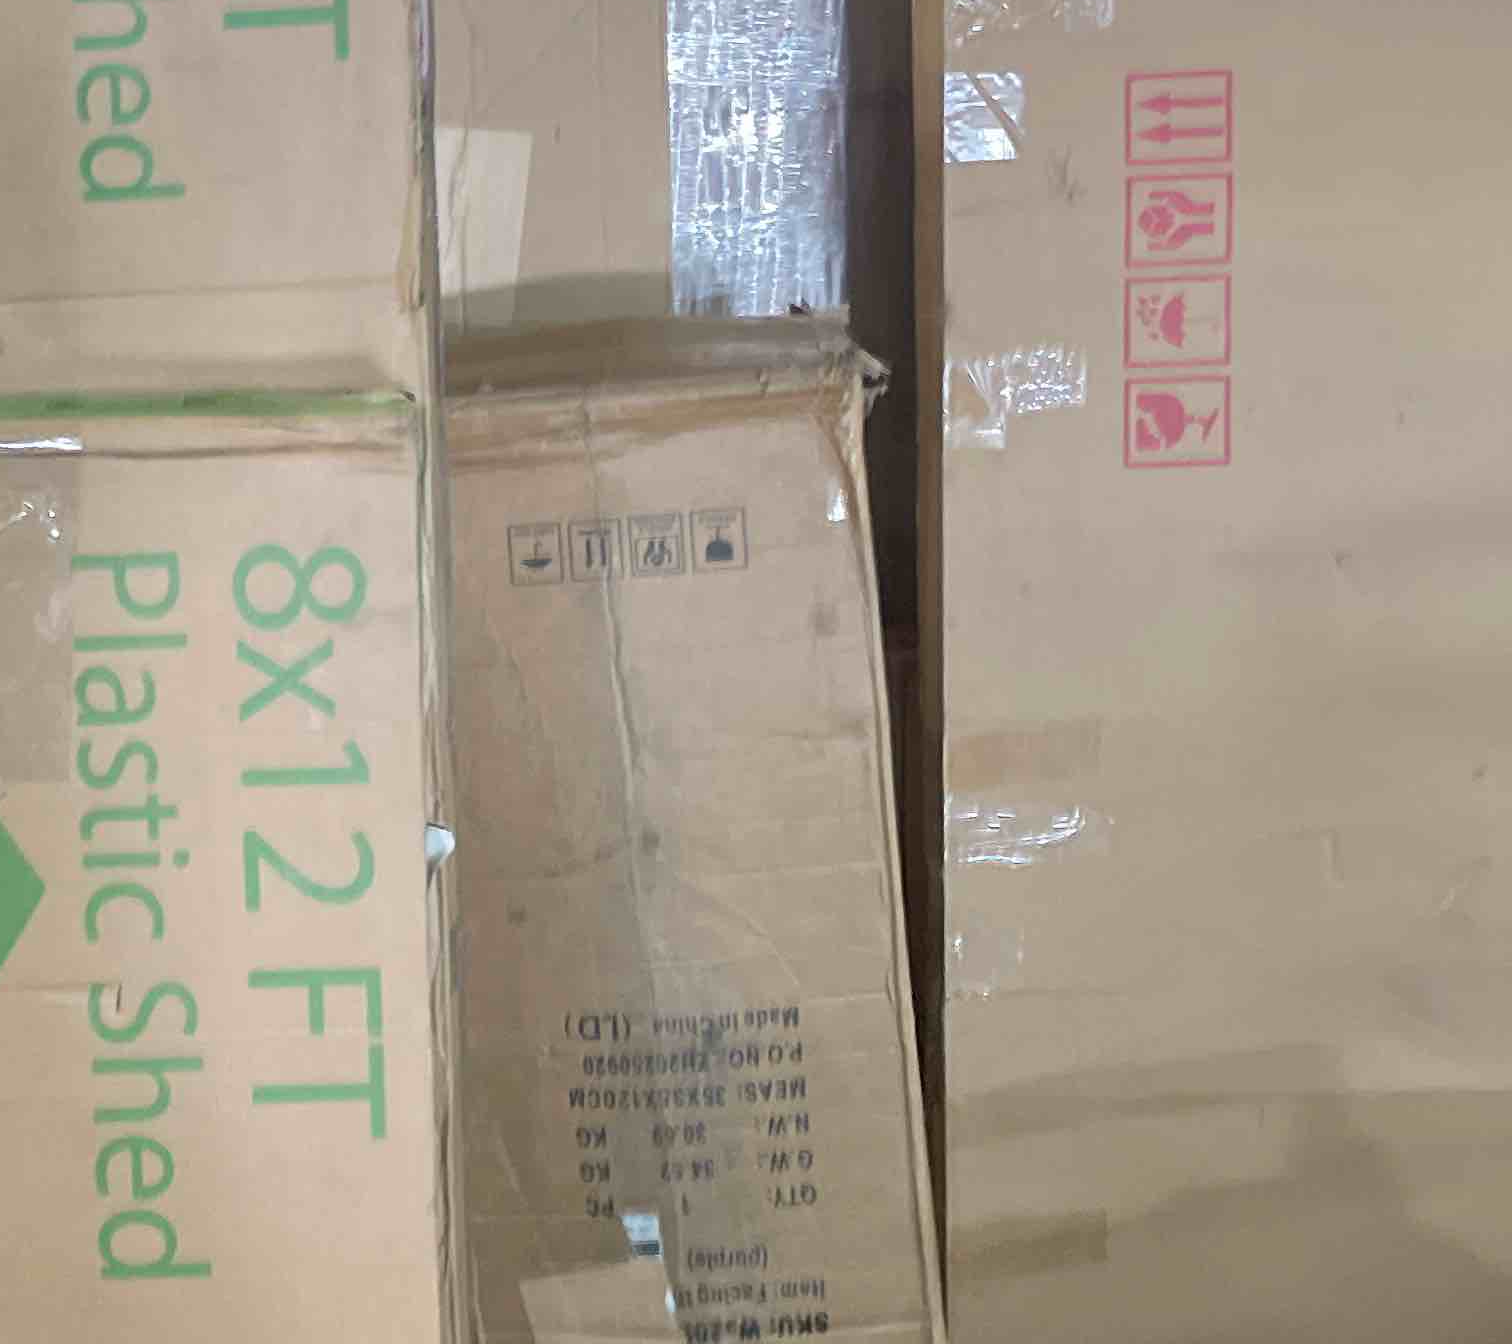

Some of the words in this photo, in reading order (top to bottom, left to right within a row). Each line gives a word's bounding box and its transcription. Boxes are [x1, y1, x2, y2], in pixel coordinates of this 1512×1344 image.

[70, 549, 191, 943] Plastic
[744, 1007, 799, 1029] Made
[88, 979, 214, 1281] Shed
[575, 1124, 608, 1148] KG
[579, 1162, 611, 1184] KG
